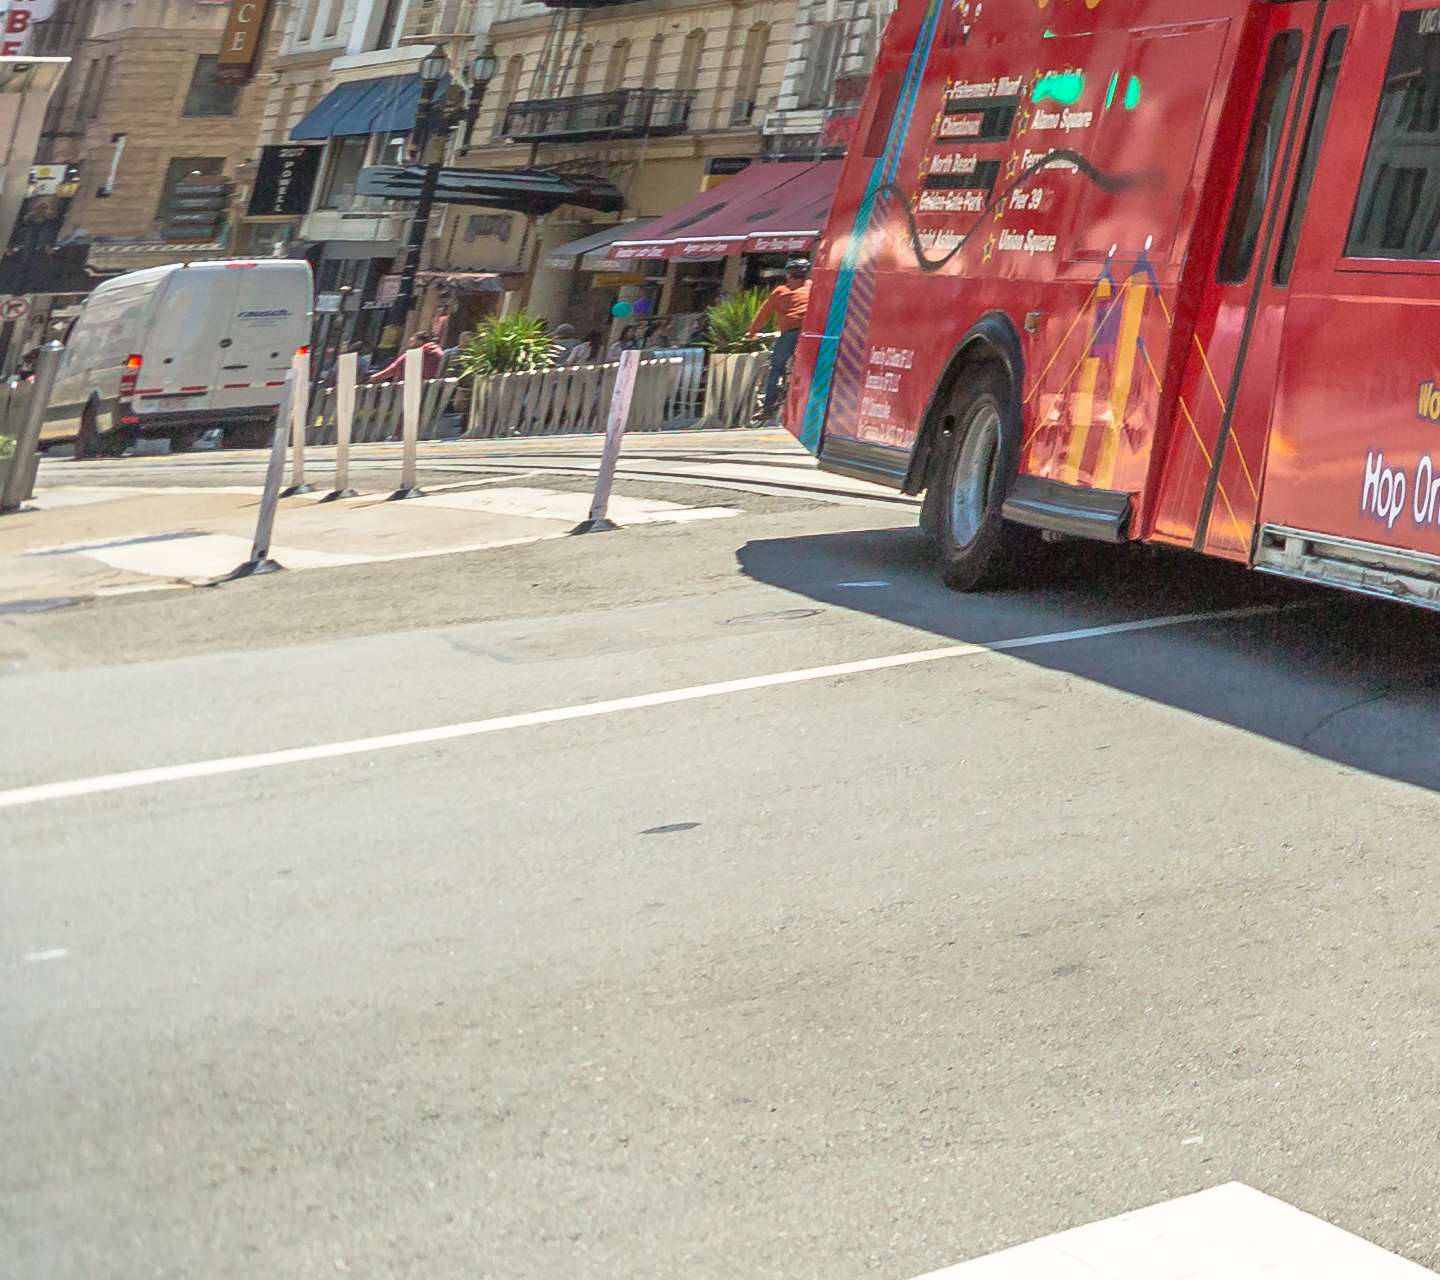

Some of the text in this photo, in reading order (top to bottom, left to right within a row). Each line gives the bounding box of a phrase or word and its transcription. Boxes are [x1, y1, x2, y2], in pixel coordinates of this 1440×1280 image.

[1030, 107, 1094, 134] Alamo Square
[930, 153, 978, 174] North Beach
[1008, 187, 1043, 210] Pier 39
[998, 228, 1057, 256] Union Square
[1361, 451, 1406, 529] Hop
